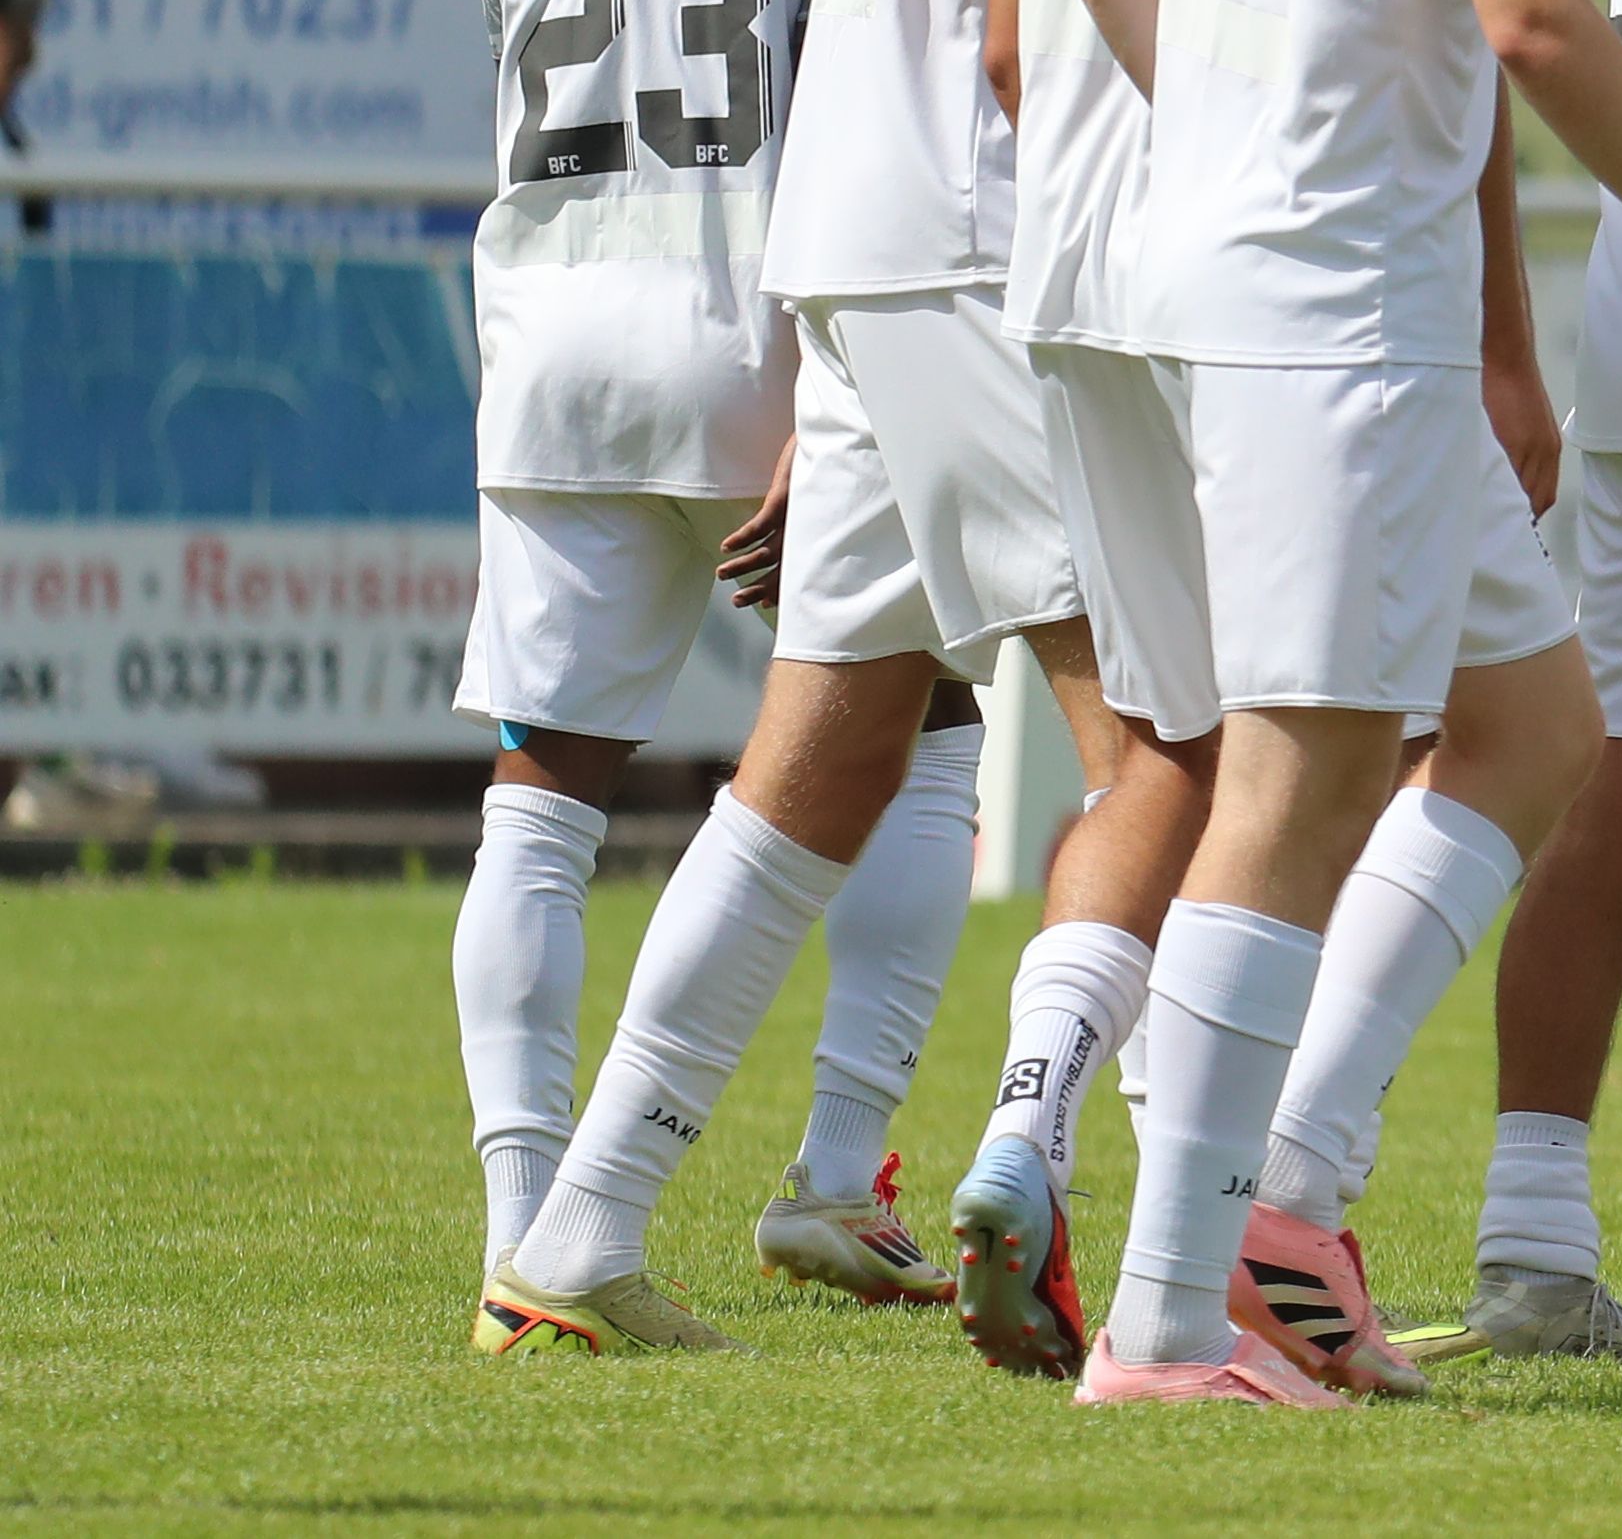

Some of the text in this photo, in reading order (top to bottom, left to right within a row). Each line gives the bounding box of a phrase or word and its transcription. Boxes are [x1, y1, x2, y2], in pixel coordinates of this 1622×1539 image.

[547, 153, 583, 176] BFC
[695, 144, 730, 164] BFC
[181, 529, 482, 624] Revisio
[643, 1107, 702, 1144] JAKO
